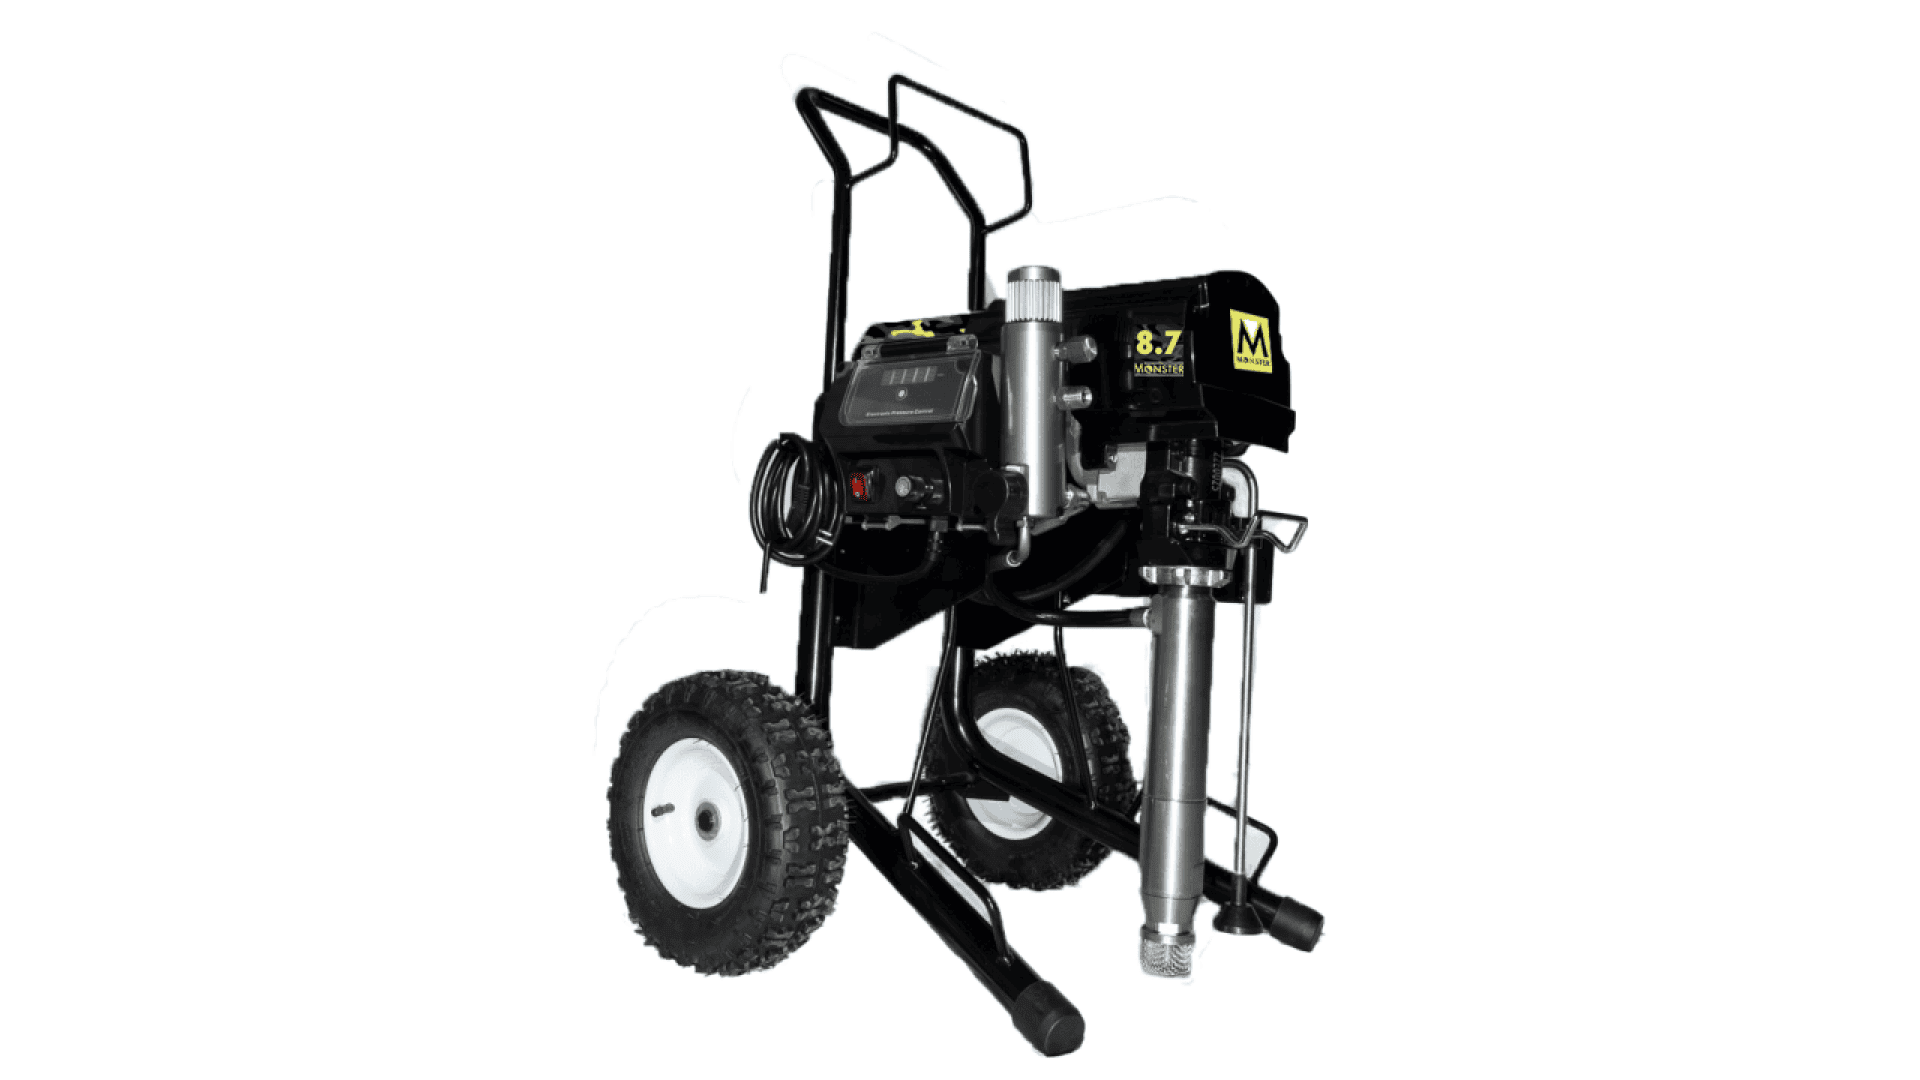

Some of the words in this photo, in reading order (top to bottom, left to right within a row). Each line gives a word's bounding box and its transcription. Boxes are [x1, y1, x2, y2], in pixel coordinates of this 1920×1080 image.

[1137, 330, 1182, 355] 8.7
[1237, 318, 1269, 357] M
[1134, 362, 1184, 374] MONSTER
